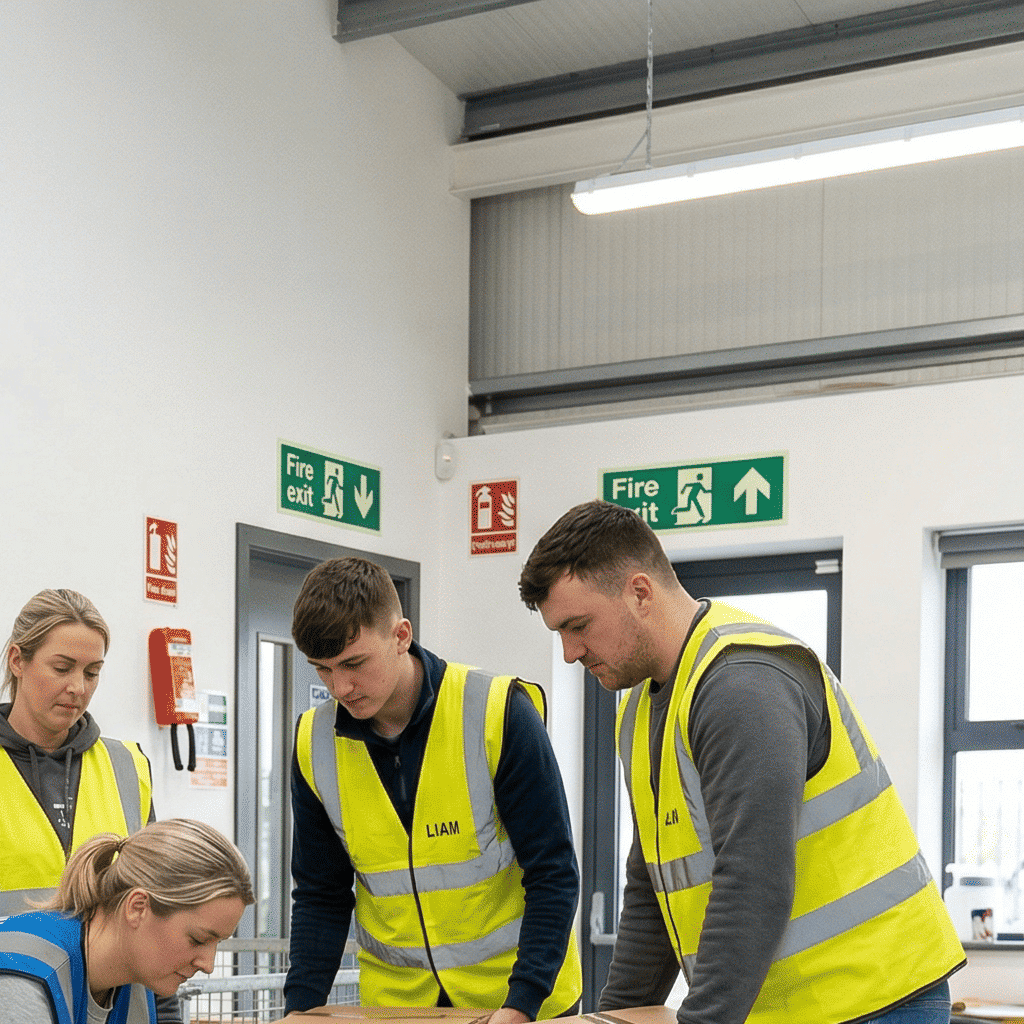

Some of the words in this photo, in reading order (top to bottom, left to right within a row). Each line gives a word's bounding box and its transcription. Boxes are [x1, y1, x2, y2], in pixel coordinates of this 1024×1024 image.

[286, 452, 314, 481] Fire
[287, 484, 314, 508] exit
[612, 477, 659, 500] Fire
[634, 501, 659, 522] it
[426, 820, 460, 838] LIAM
